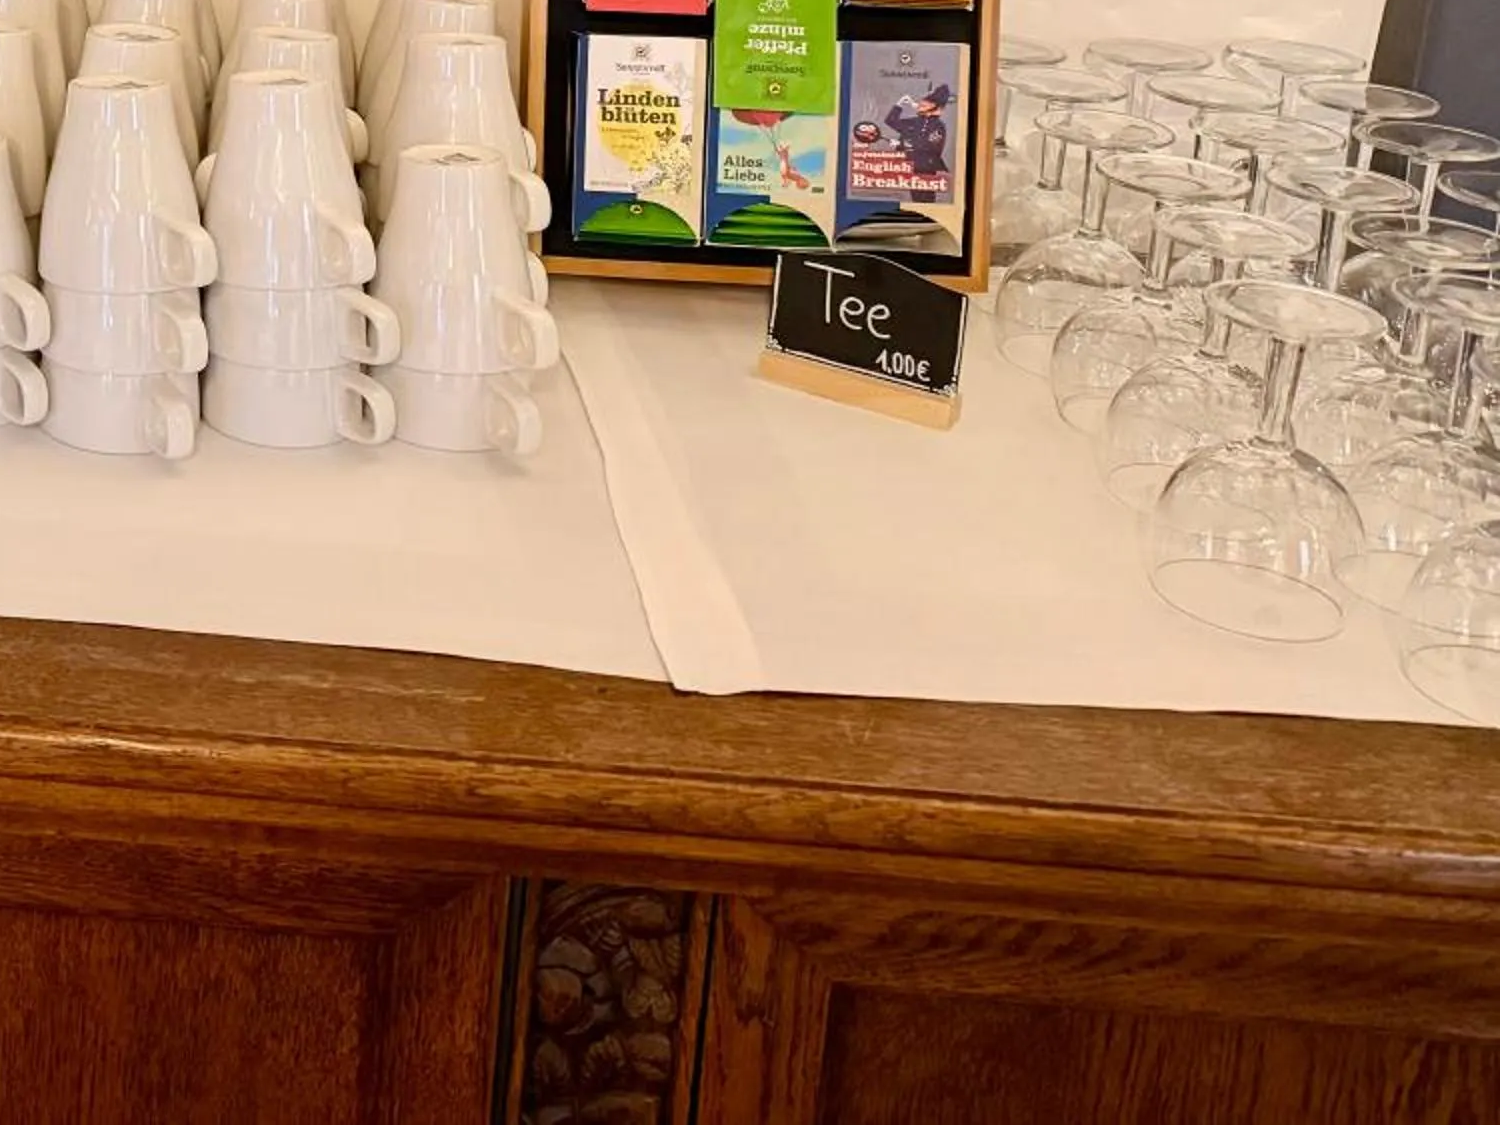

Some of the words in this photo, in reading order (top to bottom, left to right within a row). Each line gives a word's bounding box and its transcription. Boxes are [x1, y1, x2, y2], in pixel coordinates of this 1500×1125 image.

[597, 87, 681, 108] Linden
[601, 106, 677, 125] blüten
[723, 154, 764, 168] Alles
[852, 159, 912, 174] English
[723, 168, 766, 182] Liebe
[852, 173, 948, 192] Breakfast
[803, 259, 891, 340] Tee
